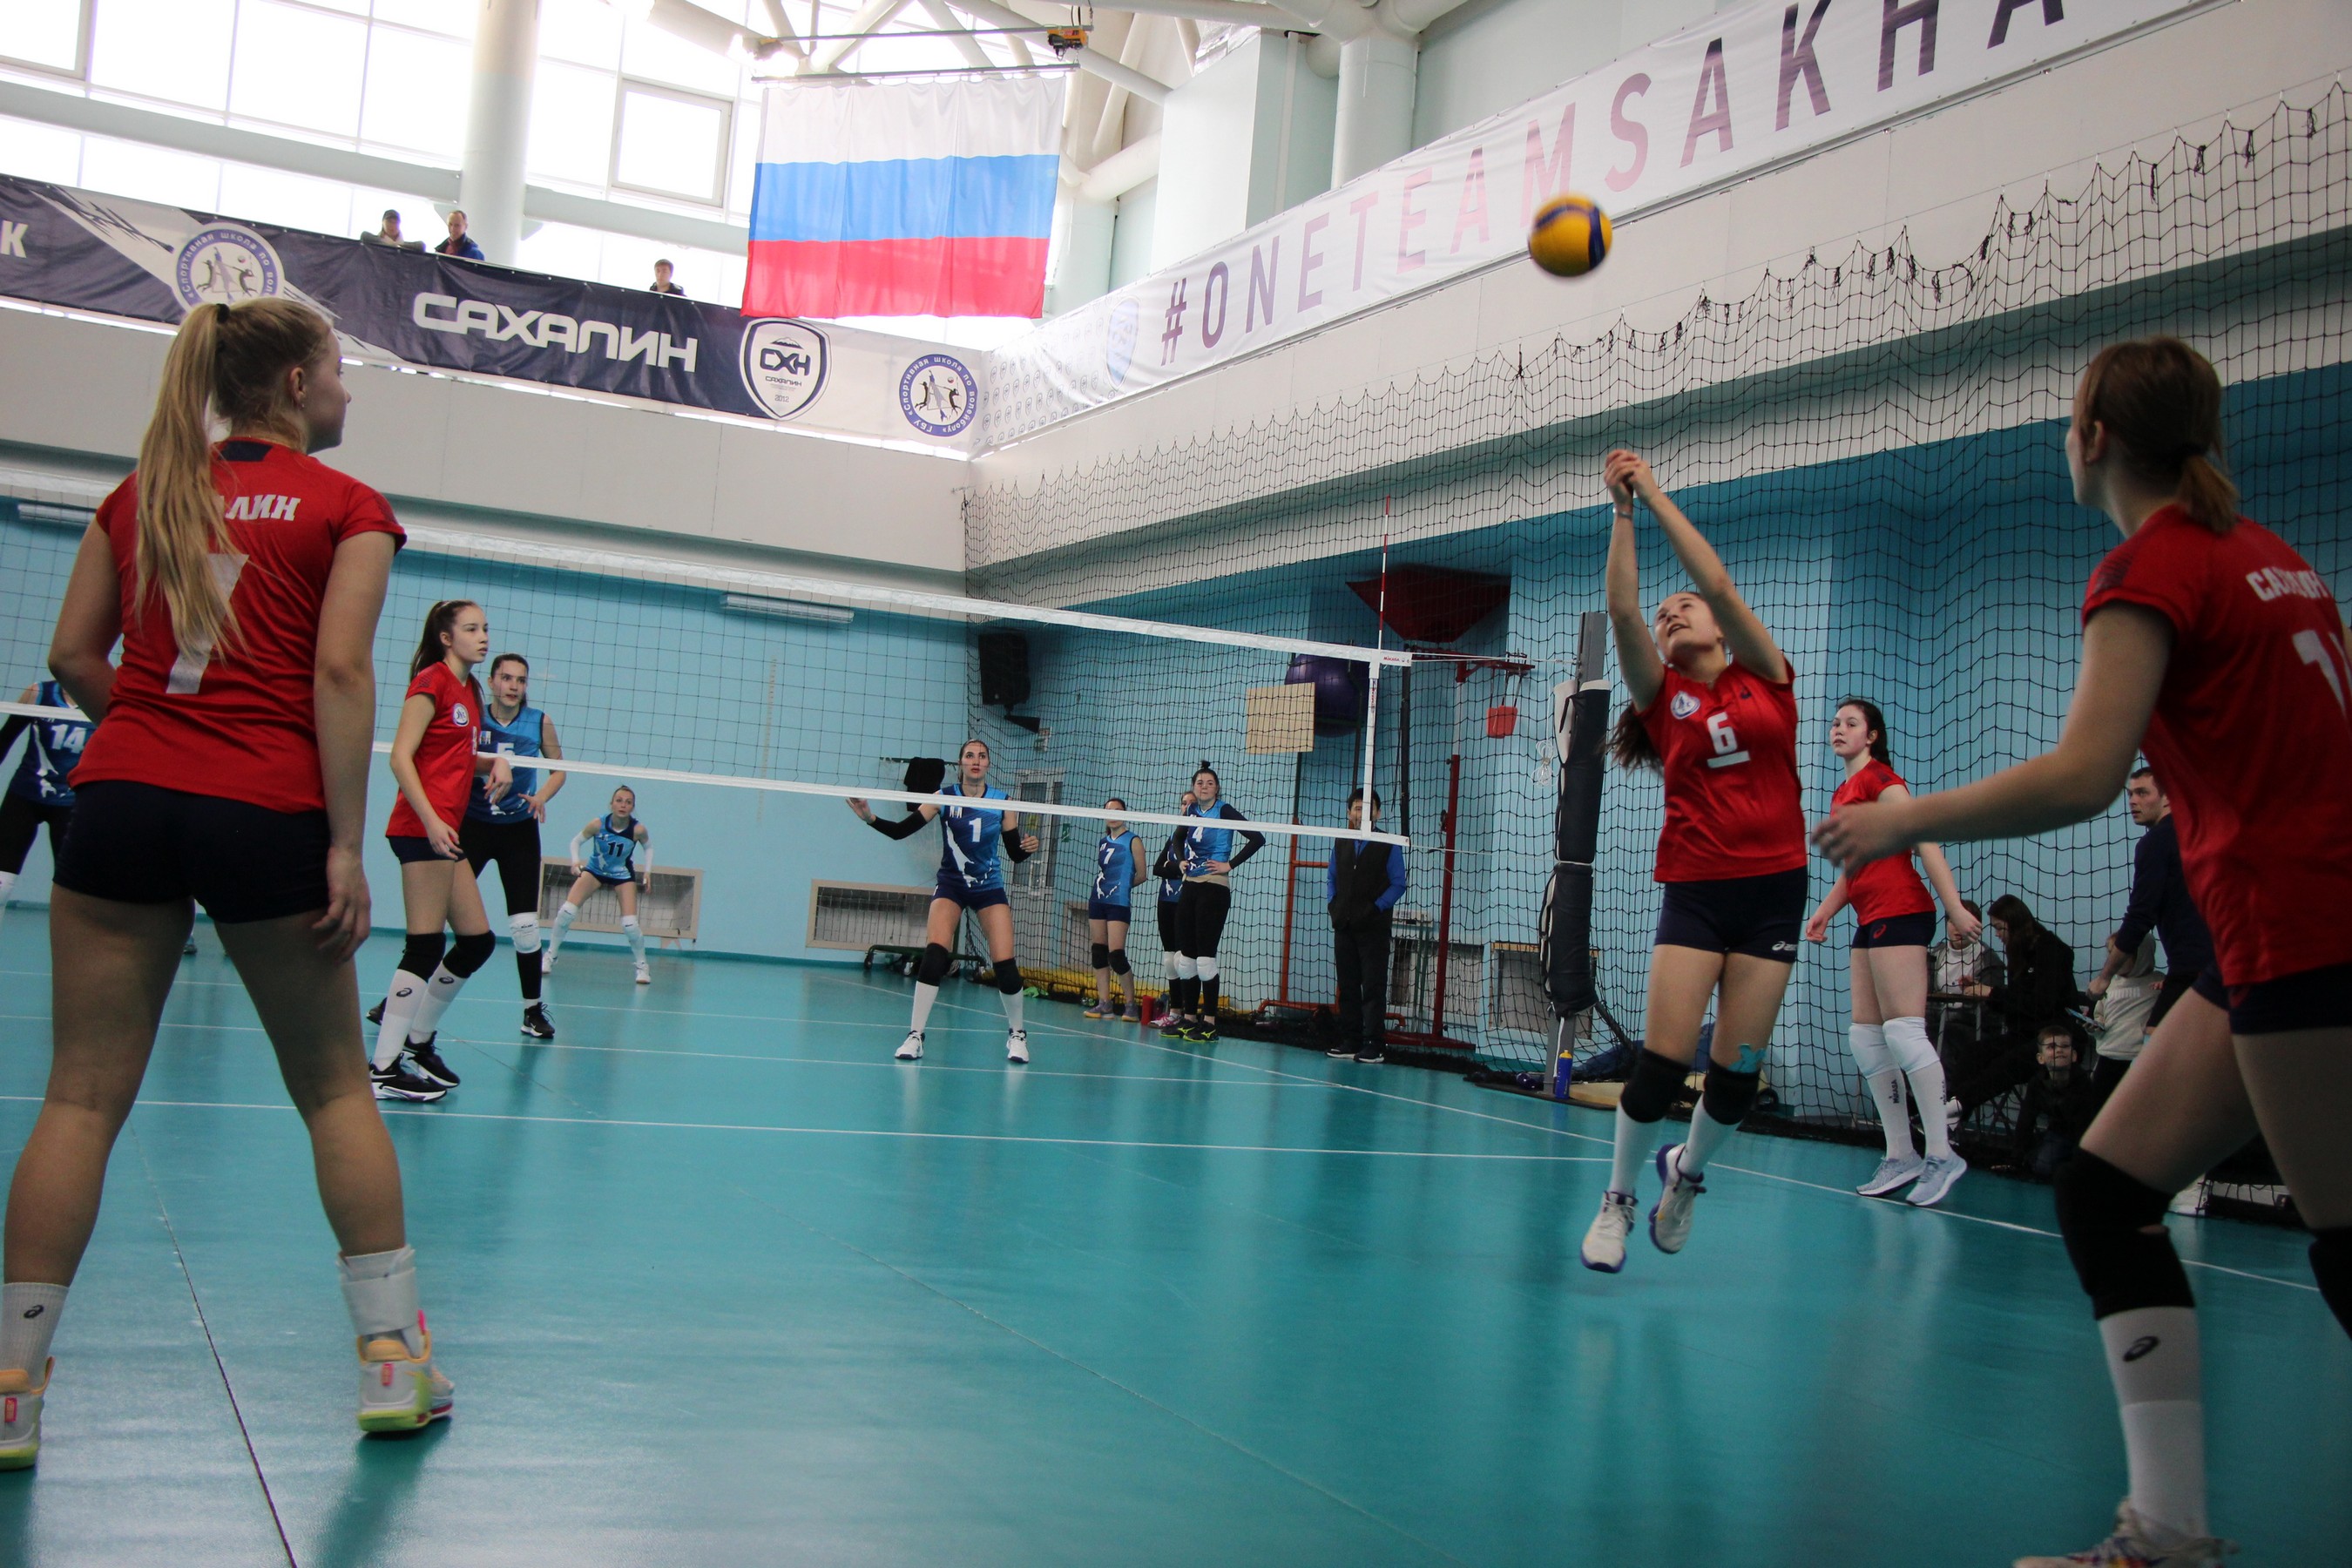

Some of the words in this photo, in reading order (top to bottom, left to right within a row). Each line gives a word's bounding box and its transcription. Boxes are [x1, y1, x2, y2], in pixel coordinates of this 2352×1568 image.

[220, 232, 257, 250] школа
[259, 252, 270, 266] по
[413, 292, 698, 373] САХАЛИН
[914, 420, 933, 433] ГБУ
[934, 356, 963, 372] школа
[963, 374, 972, 386] по
[51, 724, 86, 754] 14
[1707, 711, 1738, 755] 6
[969, 817, 982, 842] 1
[1192, 826, 1203, 842] 4
[607, 841, 624, 857] 11
[1103, 848, 1115, 864] 7
